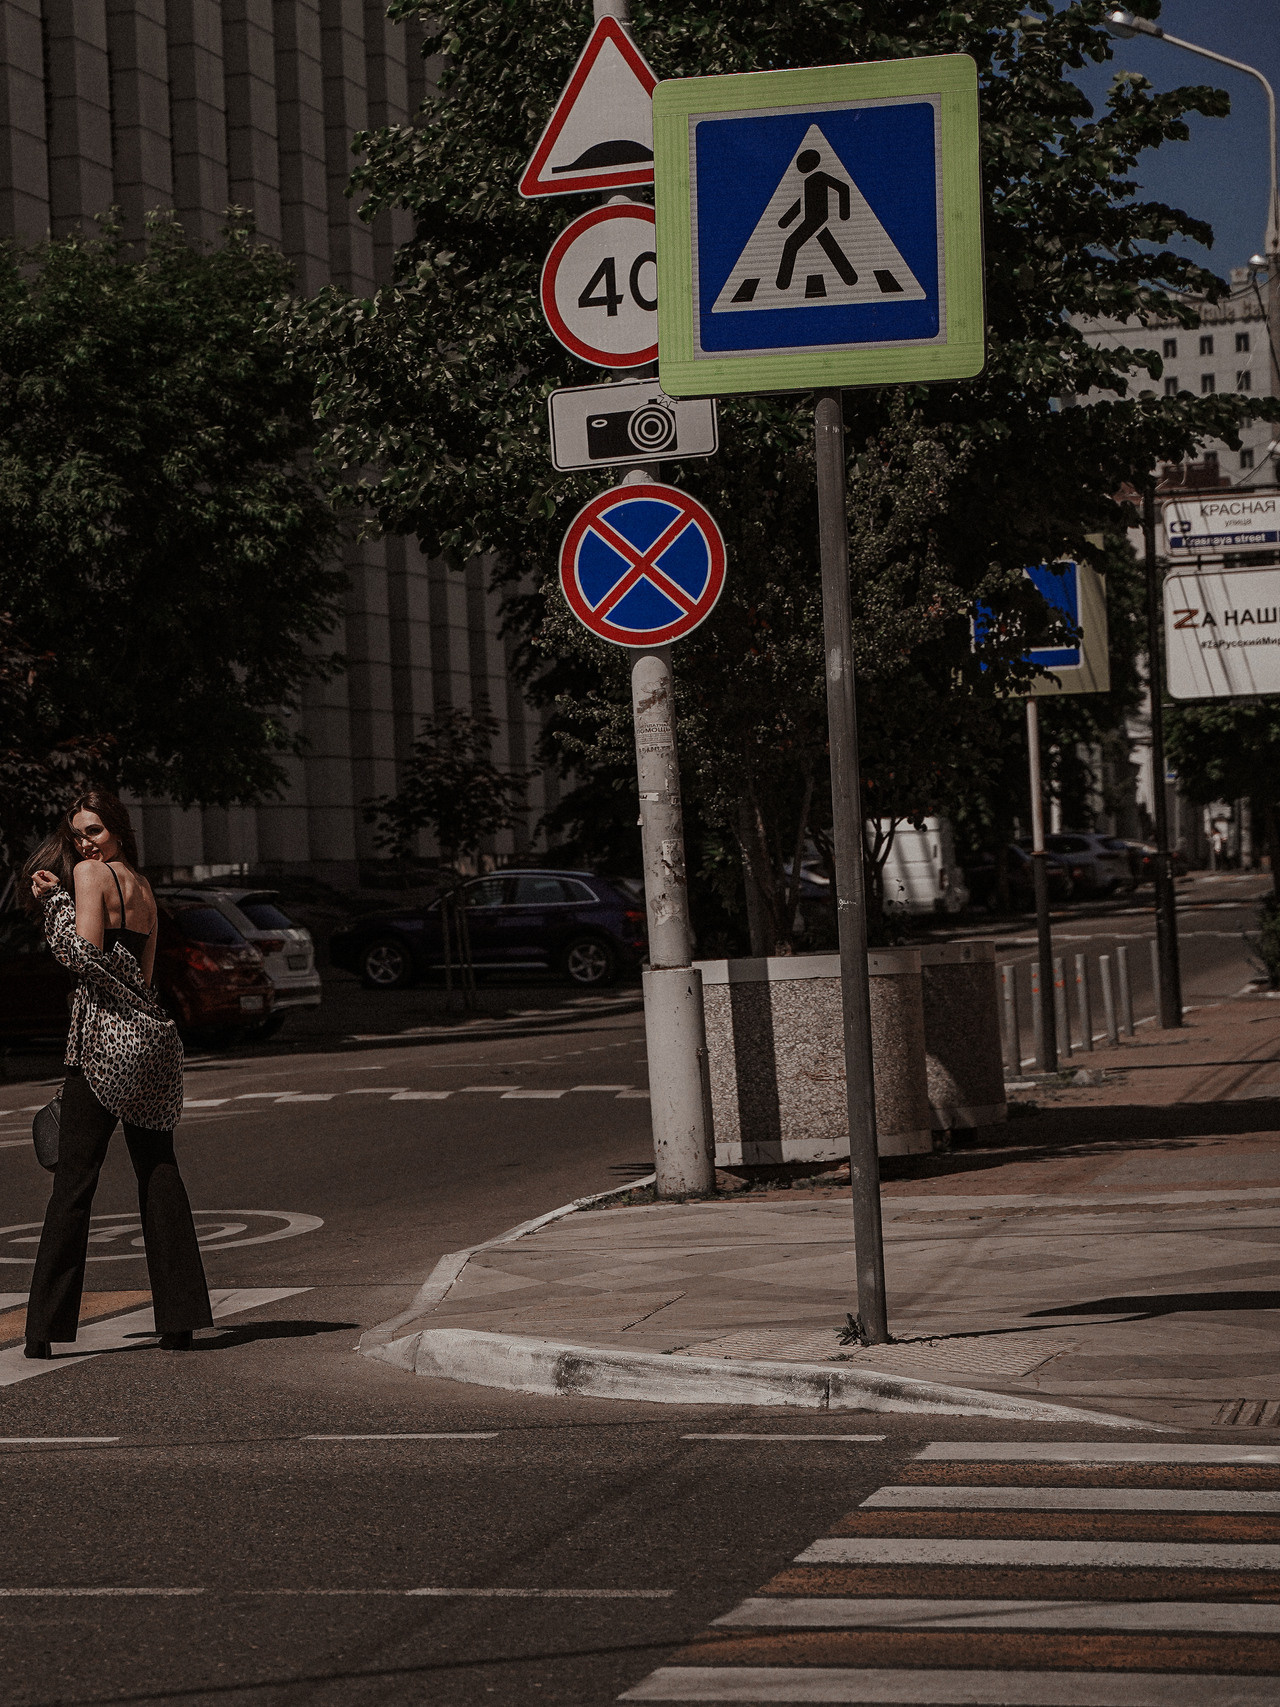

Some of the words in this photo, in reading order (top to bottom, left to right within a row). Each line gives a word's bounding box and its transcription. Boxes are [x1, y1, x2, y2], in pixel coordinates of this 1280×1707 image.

[578, 251, 658, 317] 40
[1200, 501, 1276, 516] КРАСНАЯ
[1224, 519, 1252, 527] улица
[1181, 535, 1233, 546] Krasnaya
[1234, 533, 1265, 543] street
[1225, 607, 1280, 626] НАШ
